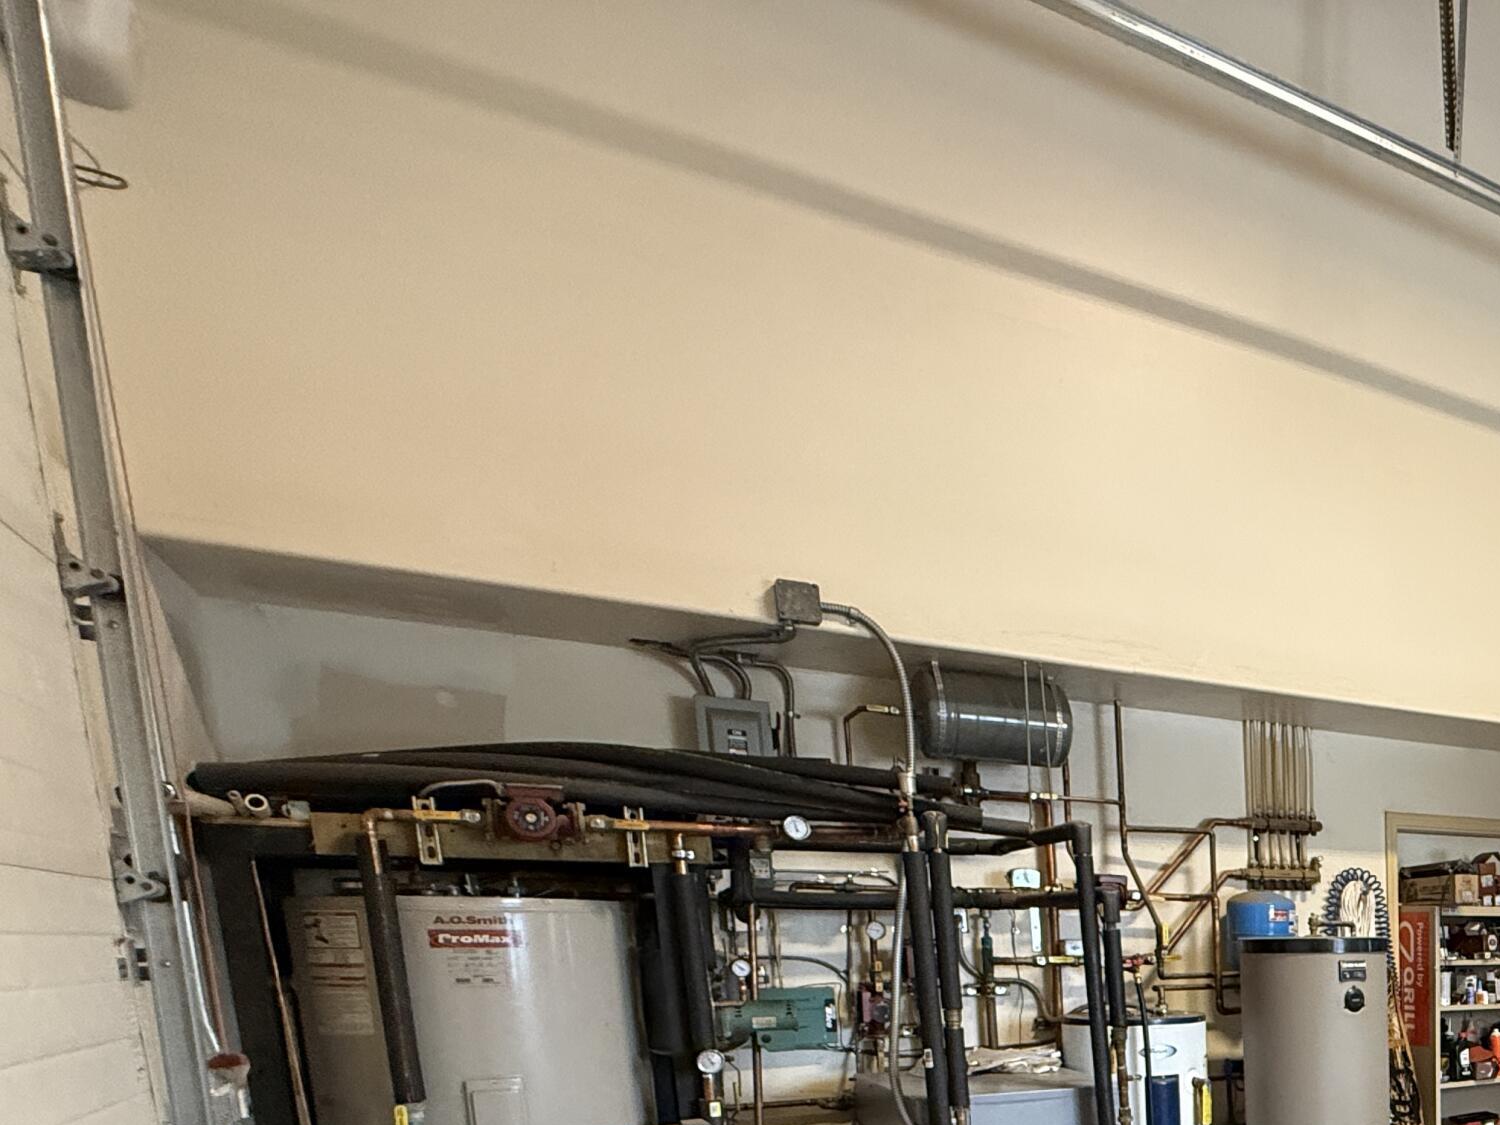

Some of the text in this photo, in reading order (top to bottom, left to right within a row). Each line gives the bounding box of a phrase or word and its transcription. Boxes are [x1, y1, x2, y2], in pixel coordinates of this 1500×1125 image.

[438, 933, 512, 944] ProMax
[1415, 921, 1425, 988] Powered by
